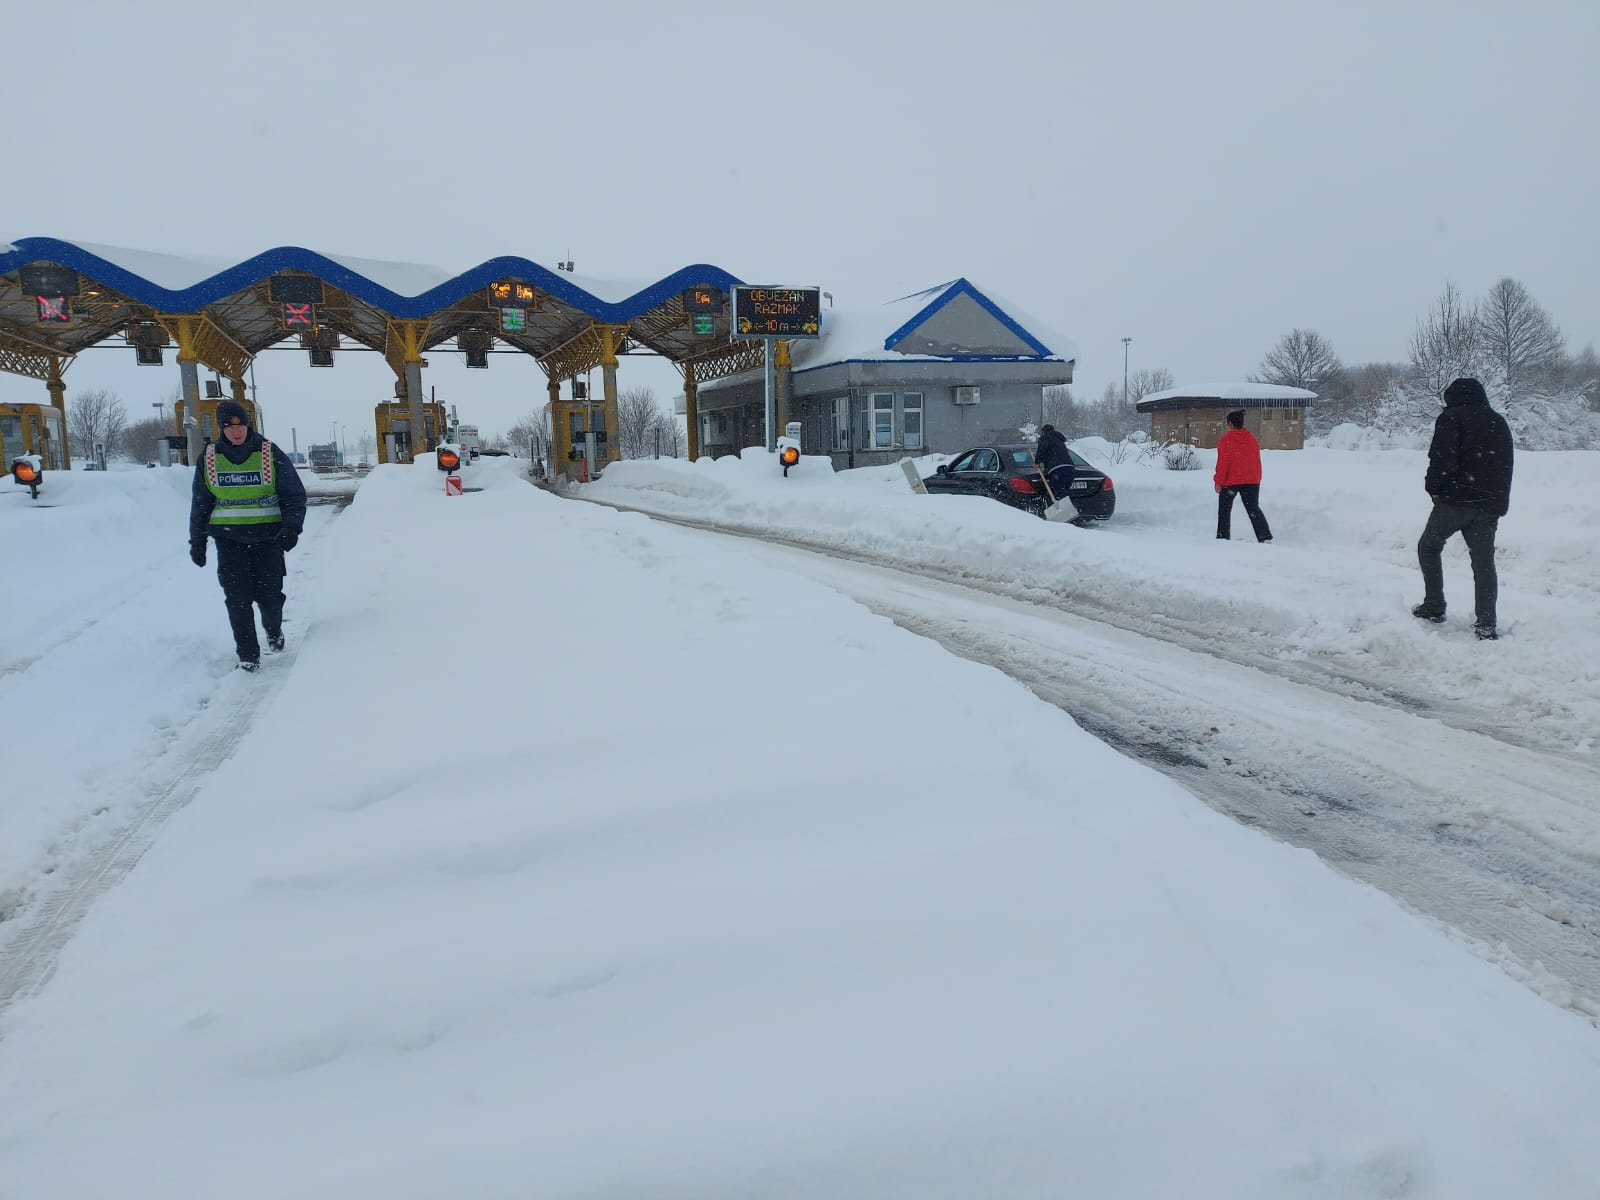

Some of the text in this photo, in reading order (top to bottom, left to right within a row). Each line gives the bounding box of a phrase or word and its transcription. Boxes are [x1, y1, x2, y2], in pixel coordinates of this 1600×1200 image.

[755, 303, 800, 314] RAZMAK
[765, 320, 777, 331] 10
[219, 475, 260, 483] POLICIJA
